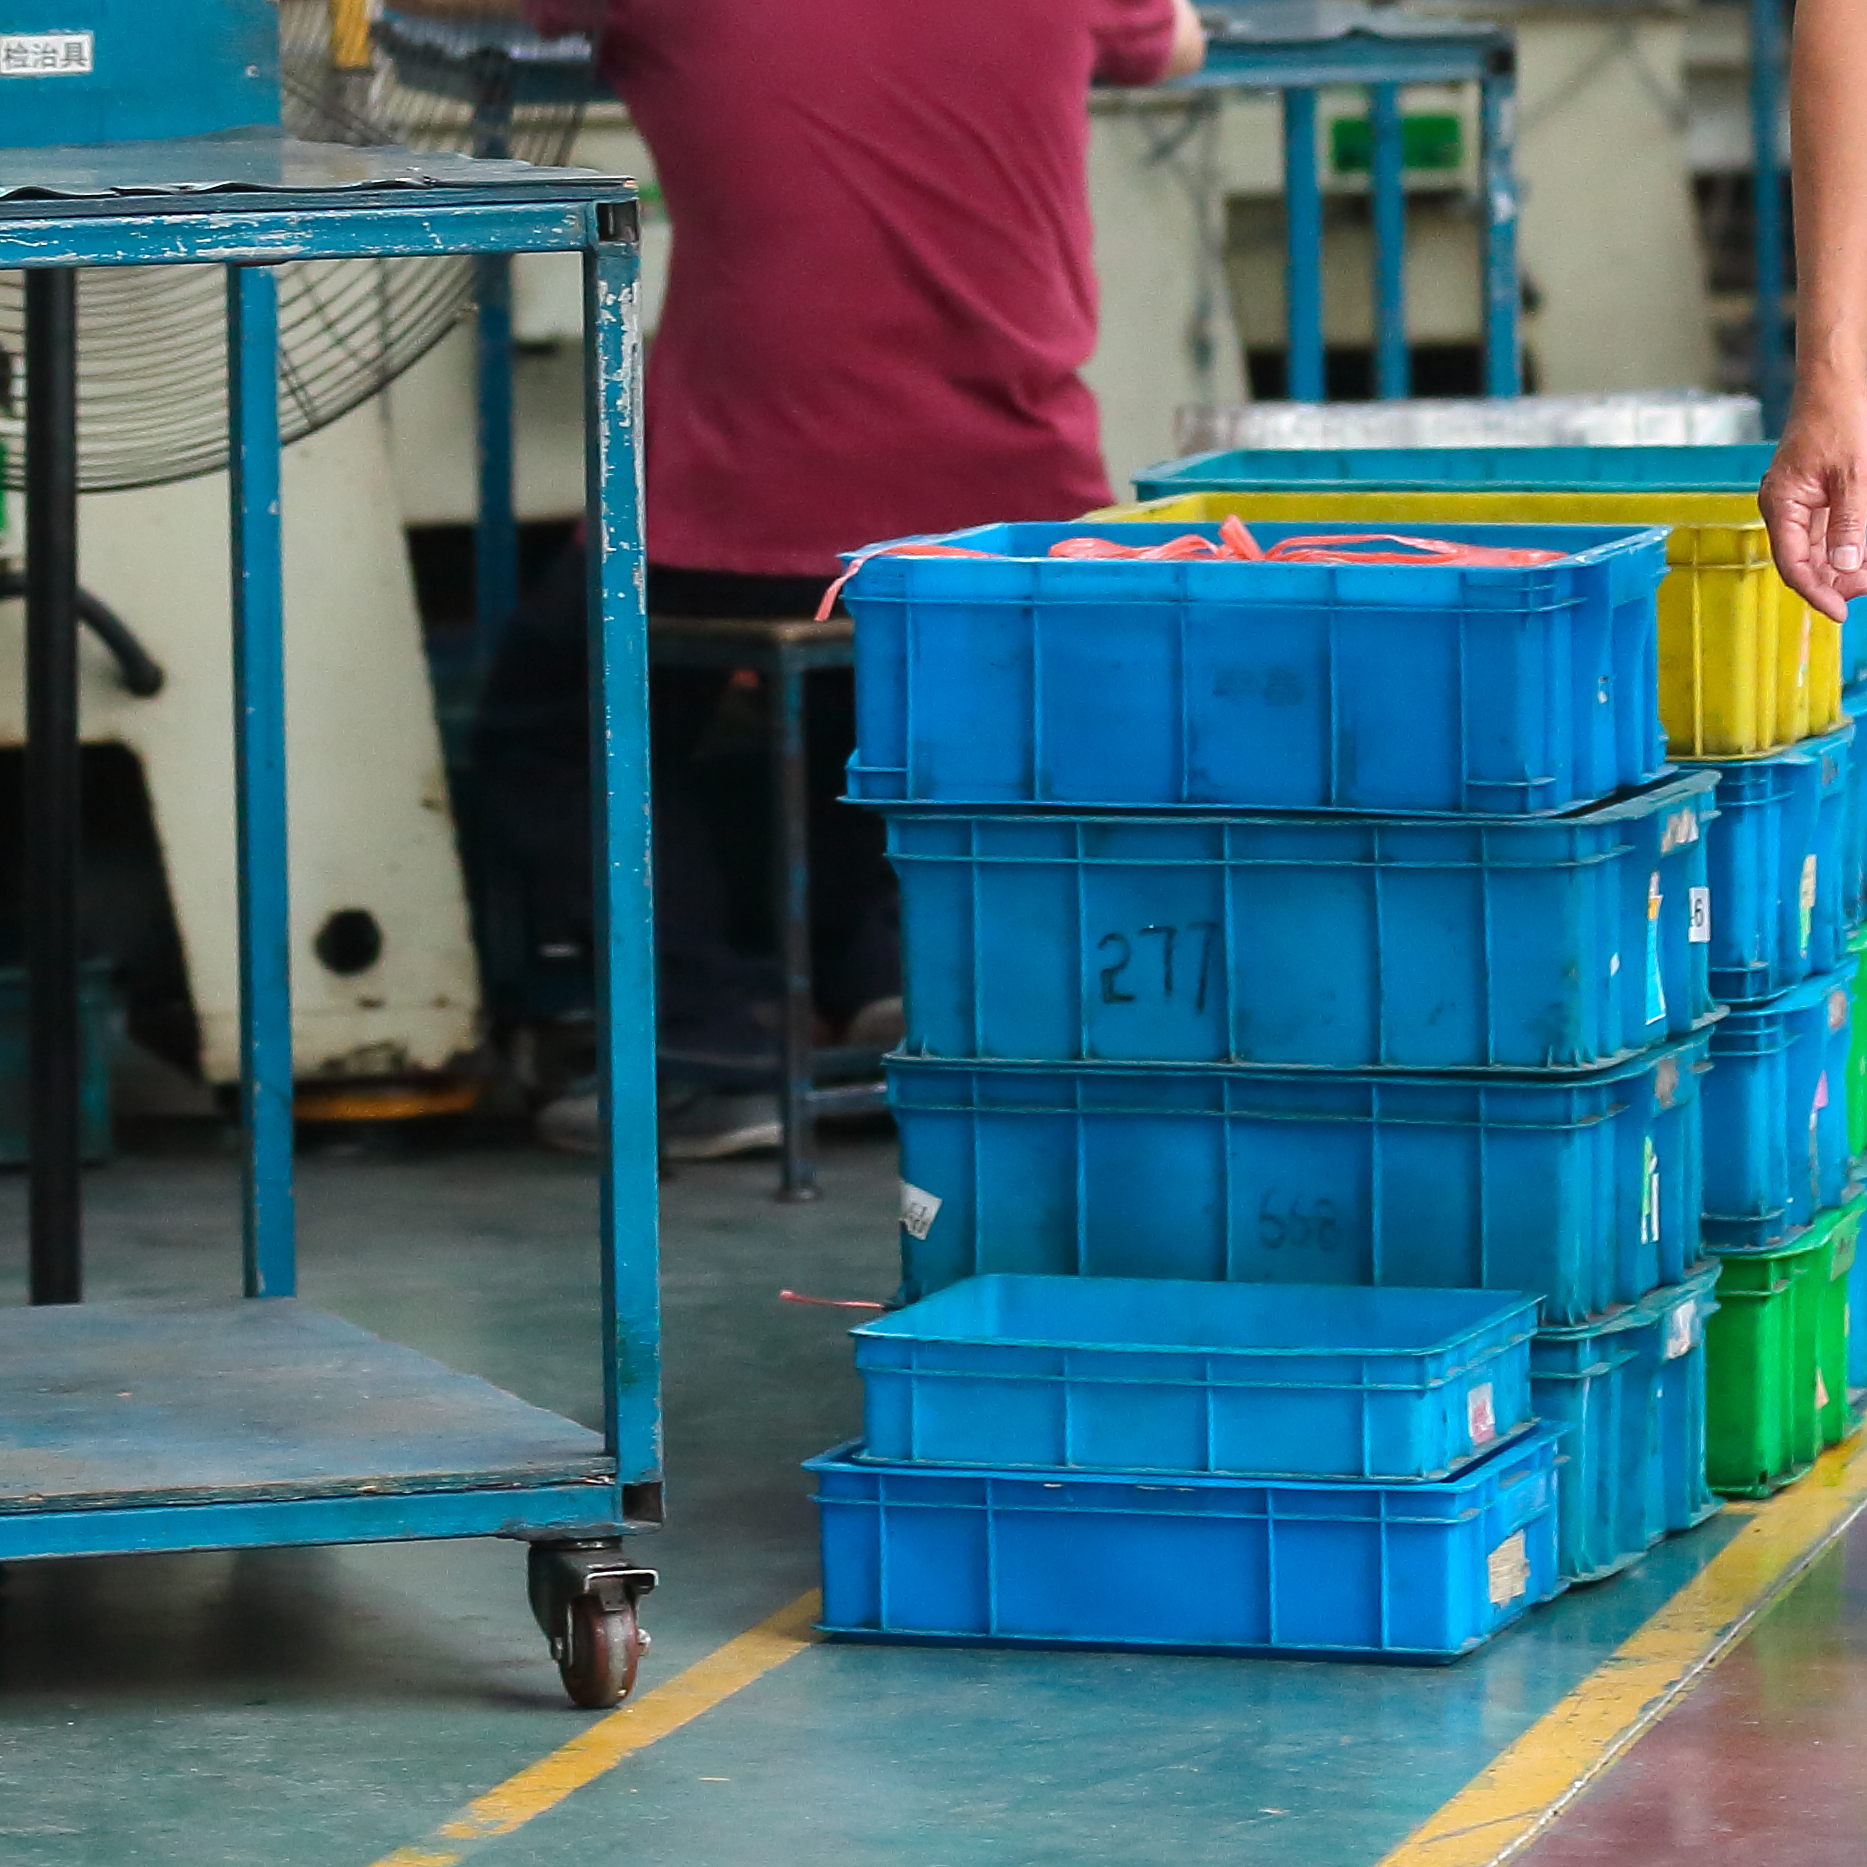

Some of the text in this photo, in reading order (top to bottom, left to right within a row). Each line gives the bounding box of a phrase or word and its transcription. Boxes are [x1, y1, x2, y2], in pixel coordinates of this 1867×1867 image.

[3, 40, 89, 70] 检治具
[1097, 920, 1220, 1013] 277
